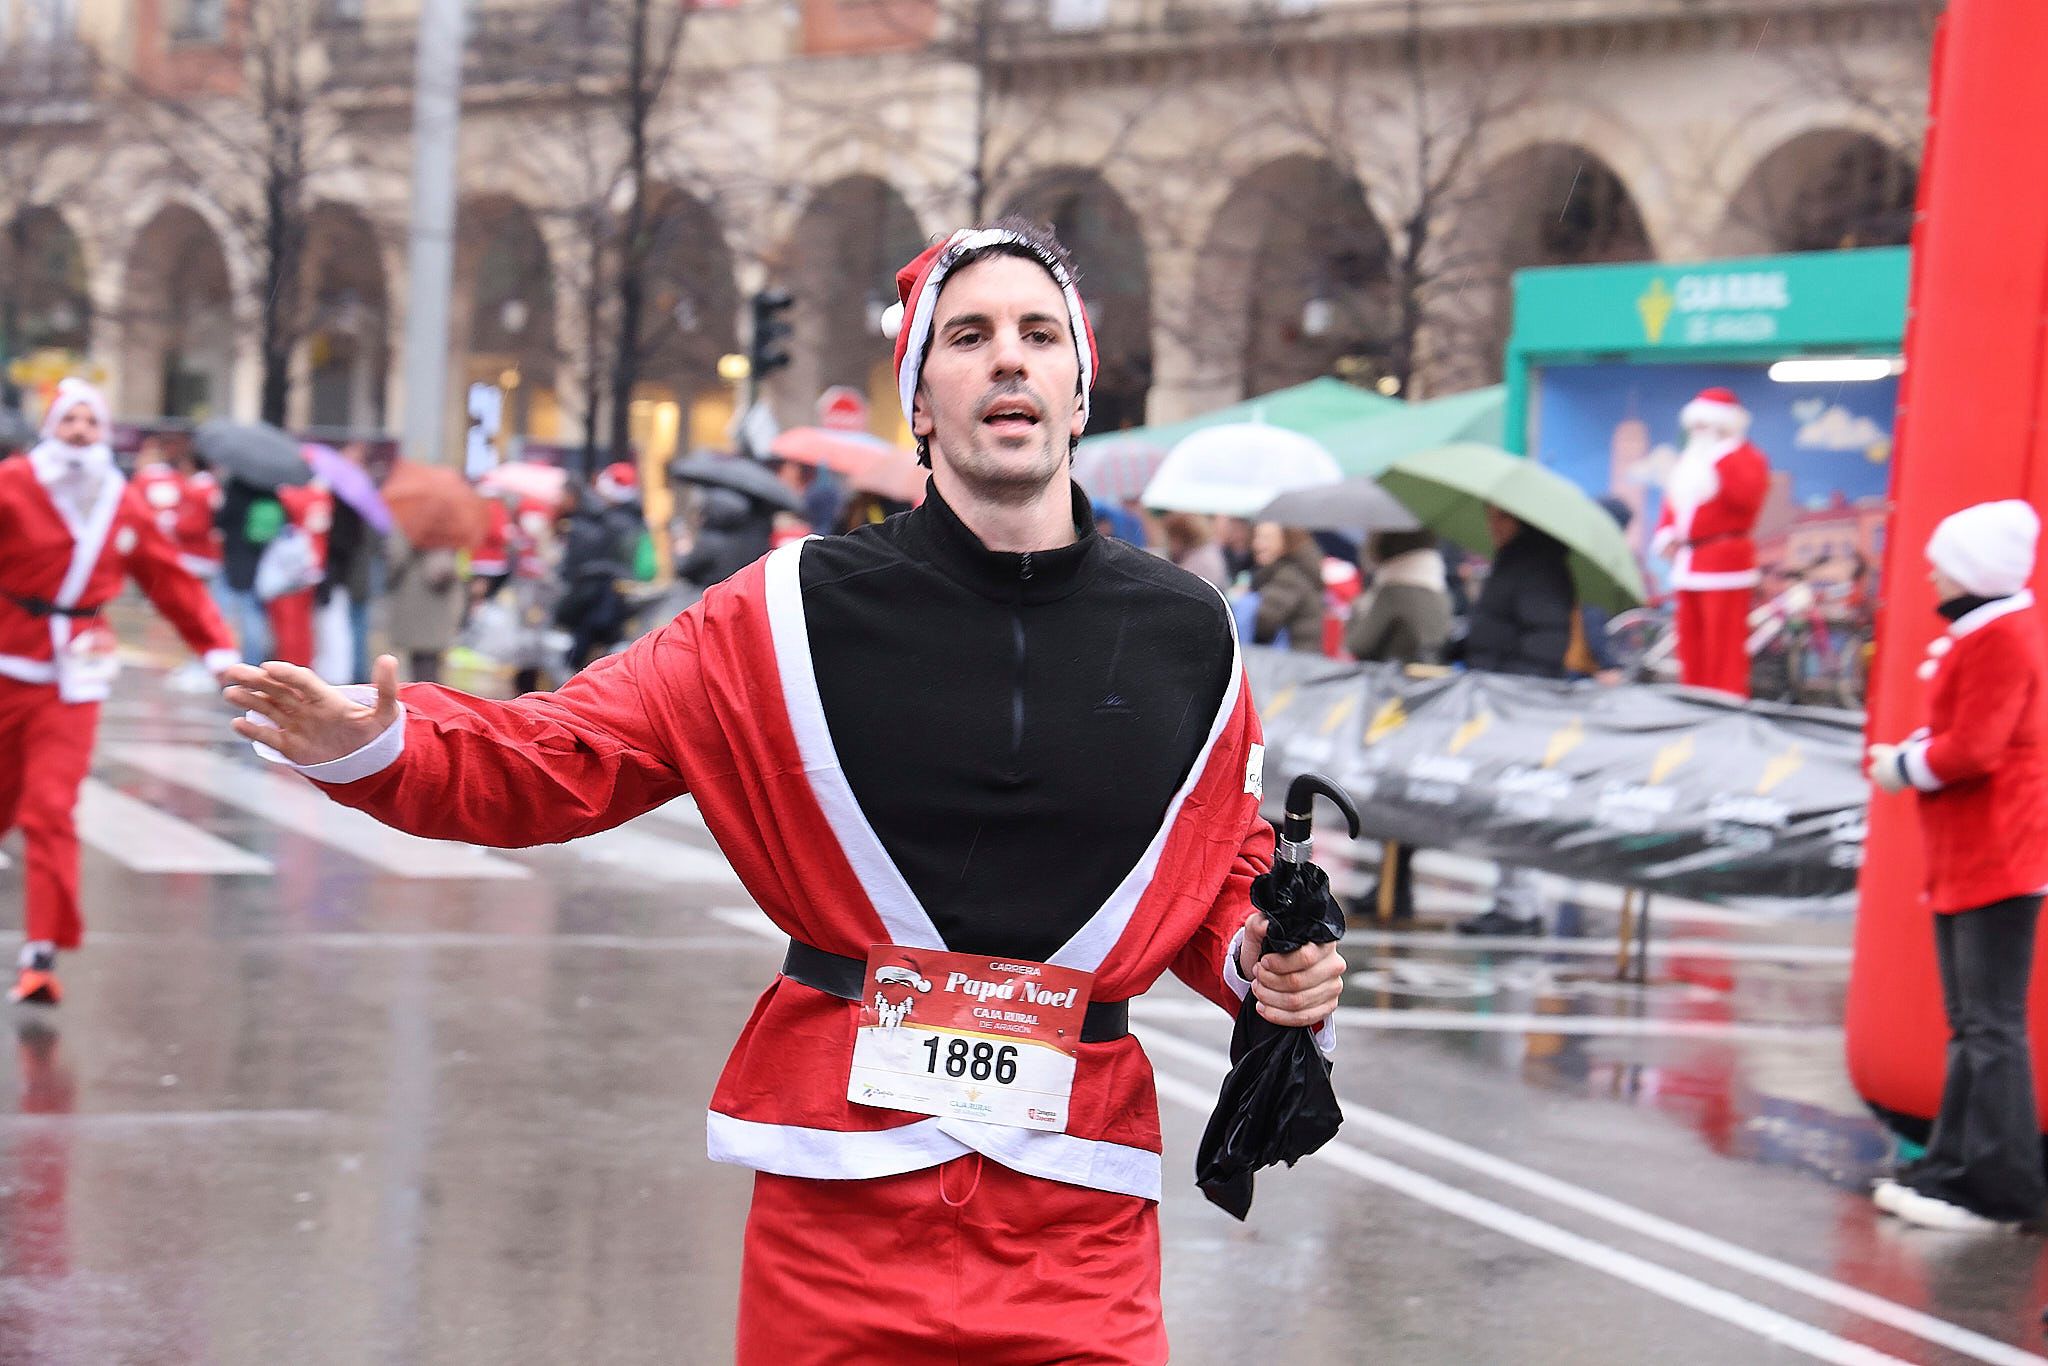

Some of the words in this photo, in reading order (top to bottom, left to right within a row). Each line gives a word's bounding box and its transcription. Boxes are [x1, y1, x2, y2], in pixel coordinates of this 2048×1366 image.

[989, 962, 1041, 976] CARRERA
[944, 972, 1015, 1003] Papá
[1019, 981, 1078, 1009] Noel
[973, 1007, 1003, 1020] CAJA
[1004, 1011, 1040, 1025] RURAL
[978, 1020, 993, 1029] DE
[923, 1035, 1018, 1085] 1886
